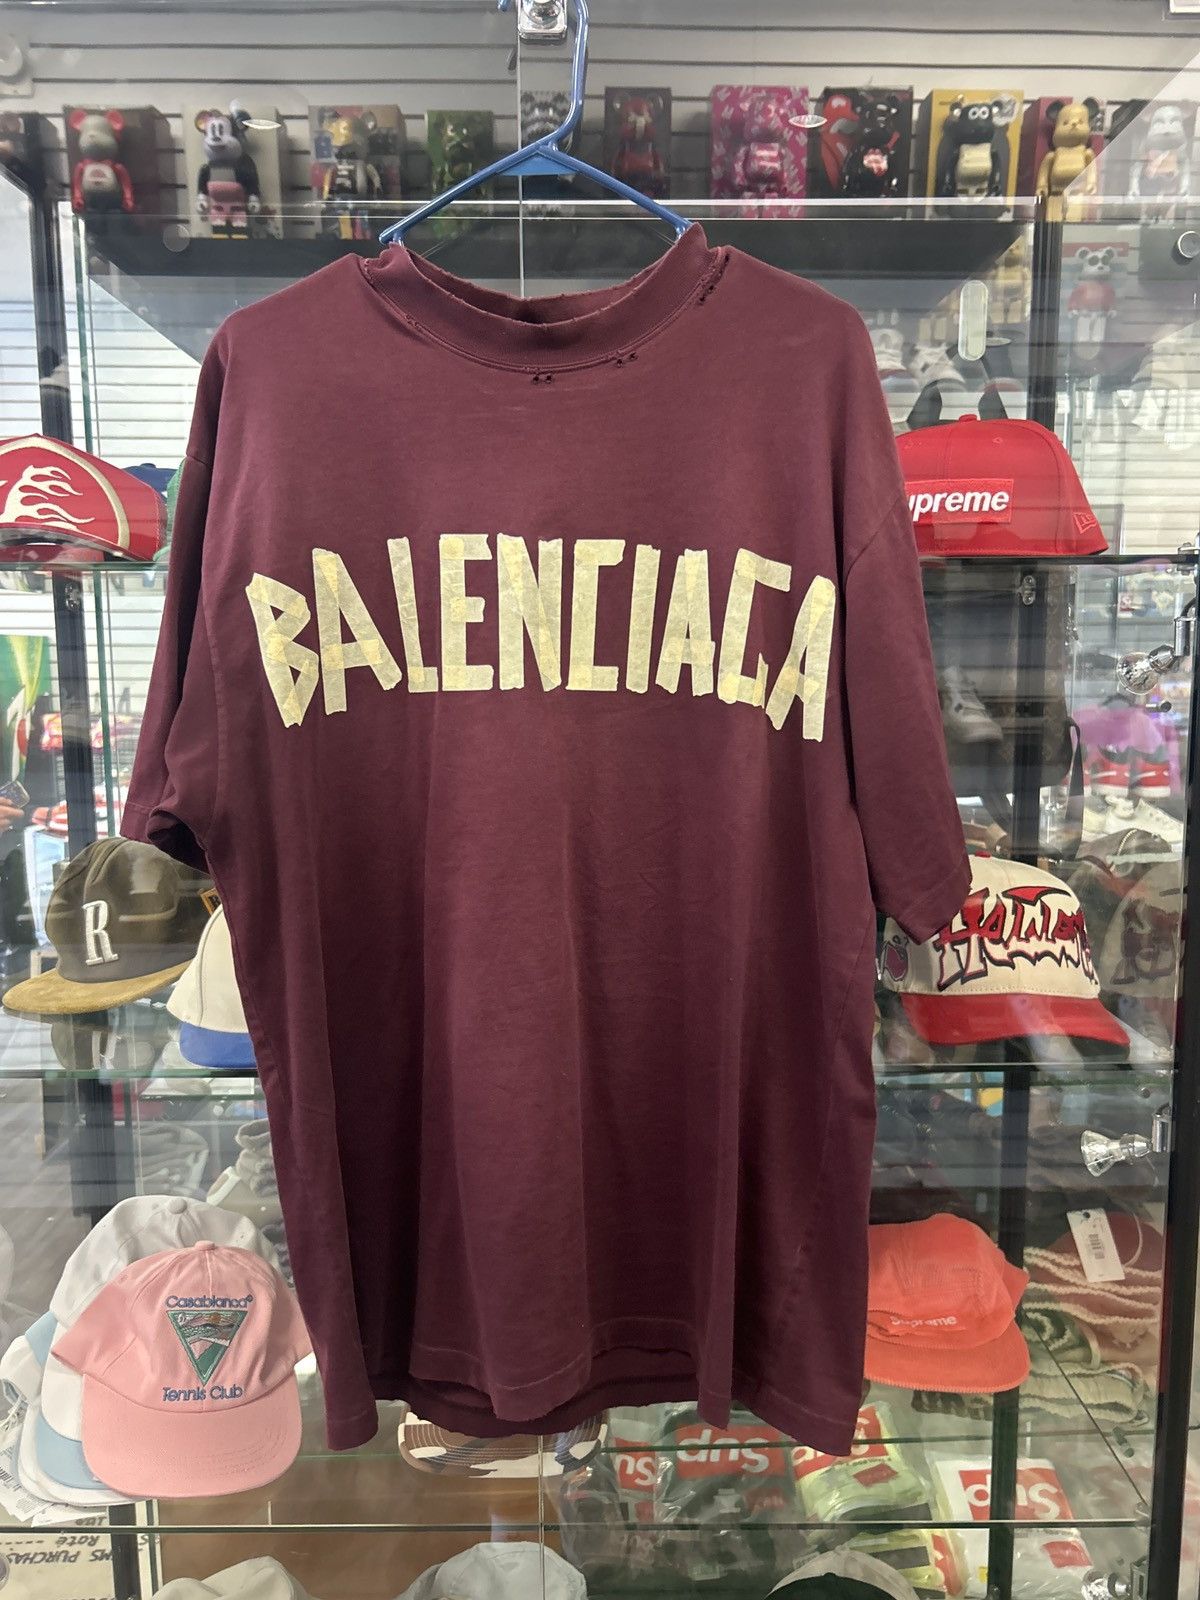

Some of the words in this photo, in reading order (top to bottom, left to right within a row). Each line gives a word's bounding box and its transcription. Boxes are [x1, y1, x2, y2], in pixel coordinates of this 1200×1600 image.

[908, 490, 1010, 522] preme
[245, 532, 836, 742] BALENCIAGA
[82, 900, 118, 966] R
[162, 1386, 207, 1402] Tennis
[209, 1384, 244, 1400] Club
[676, 1429, 769, 1473] Sup
